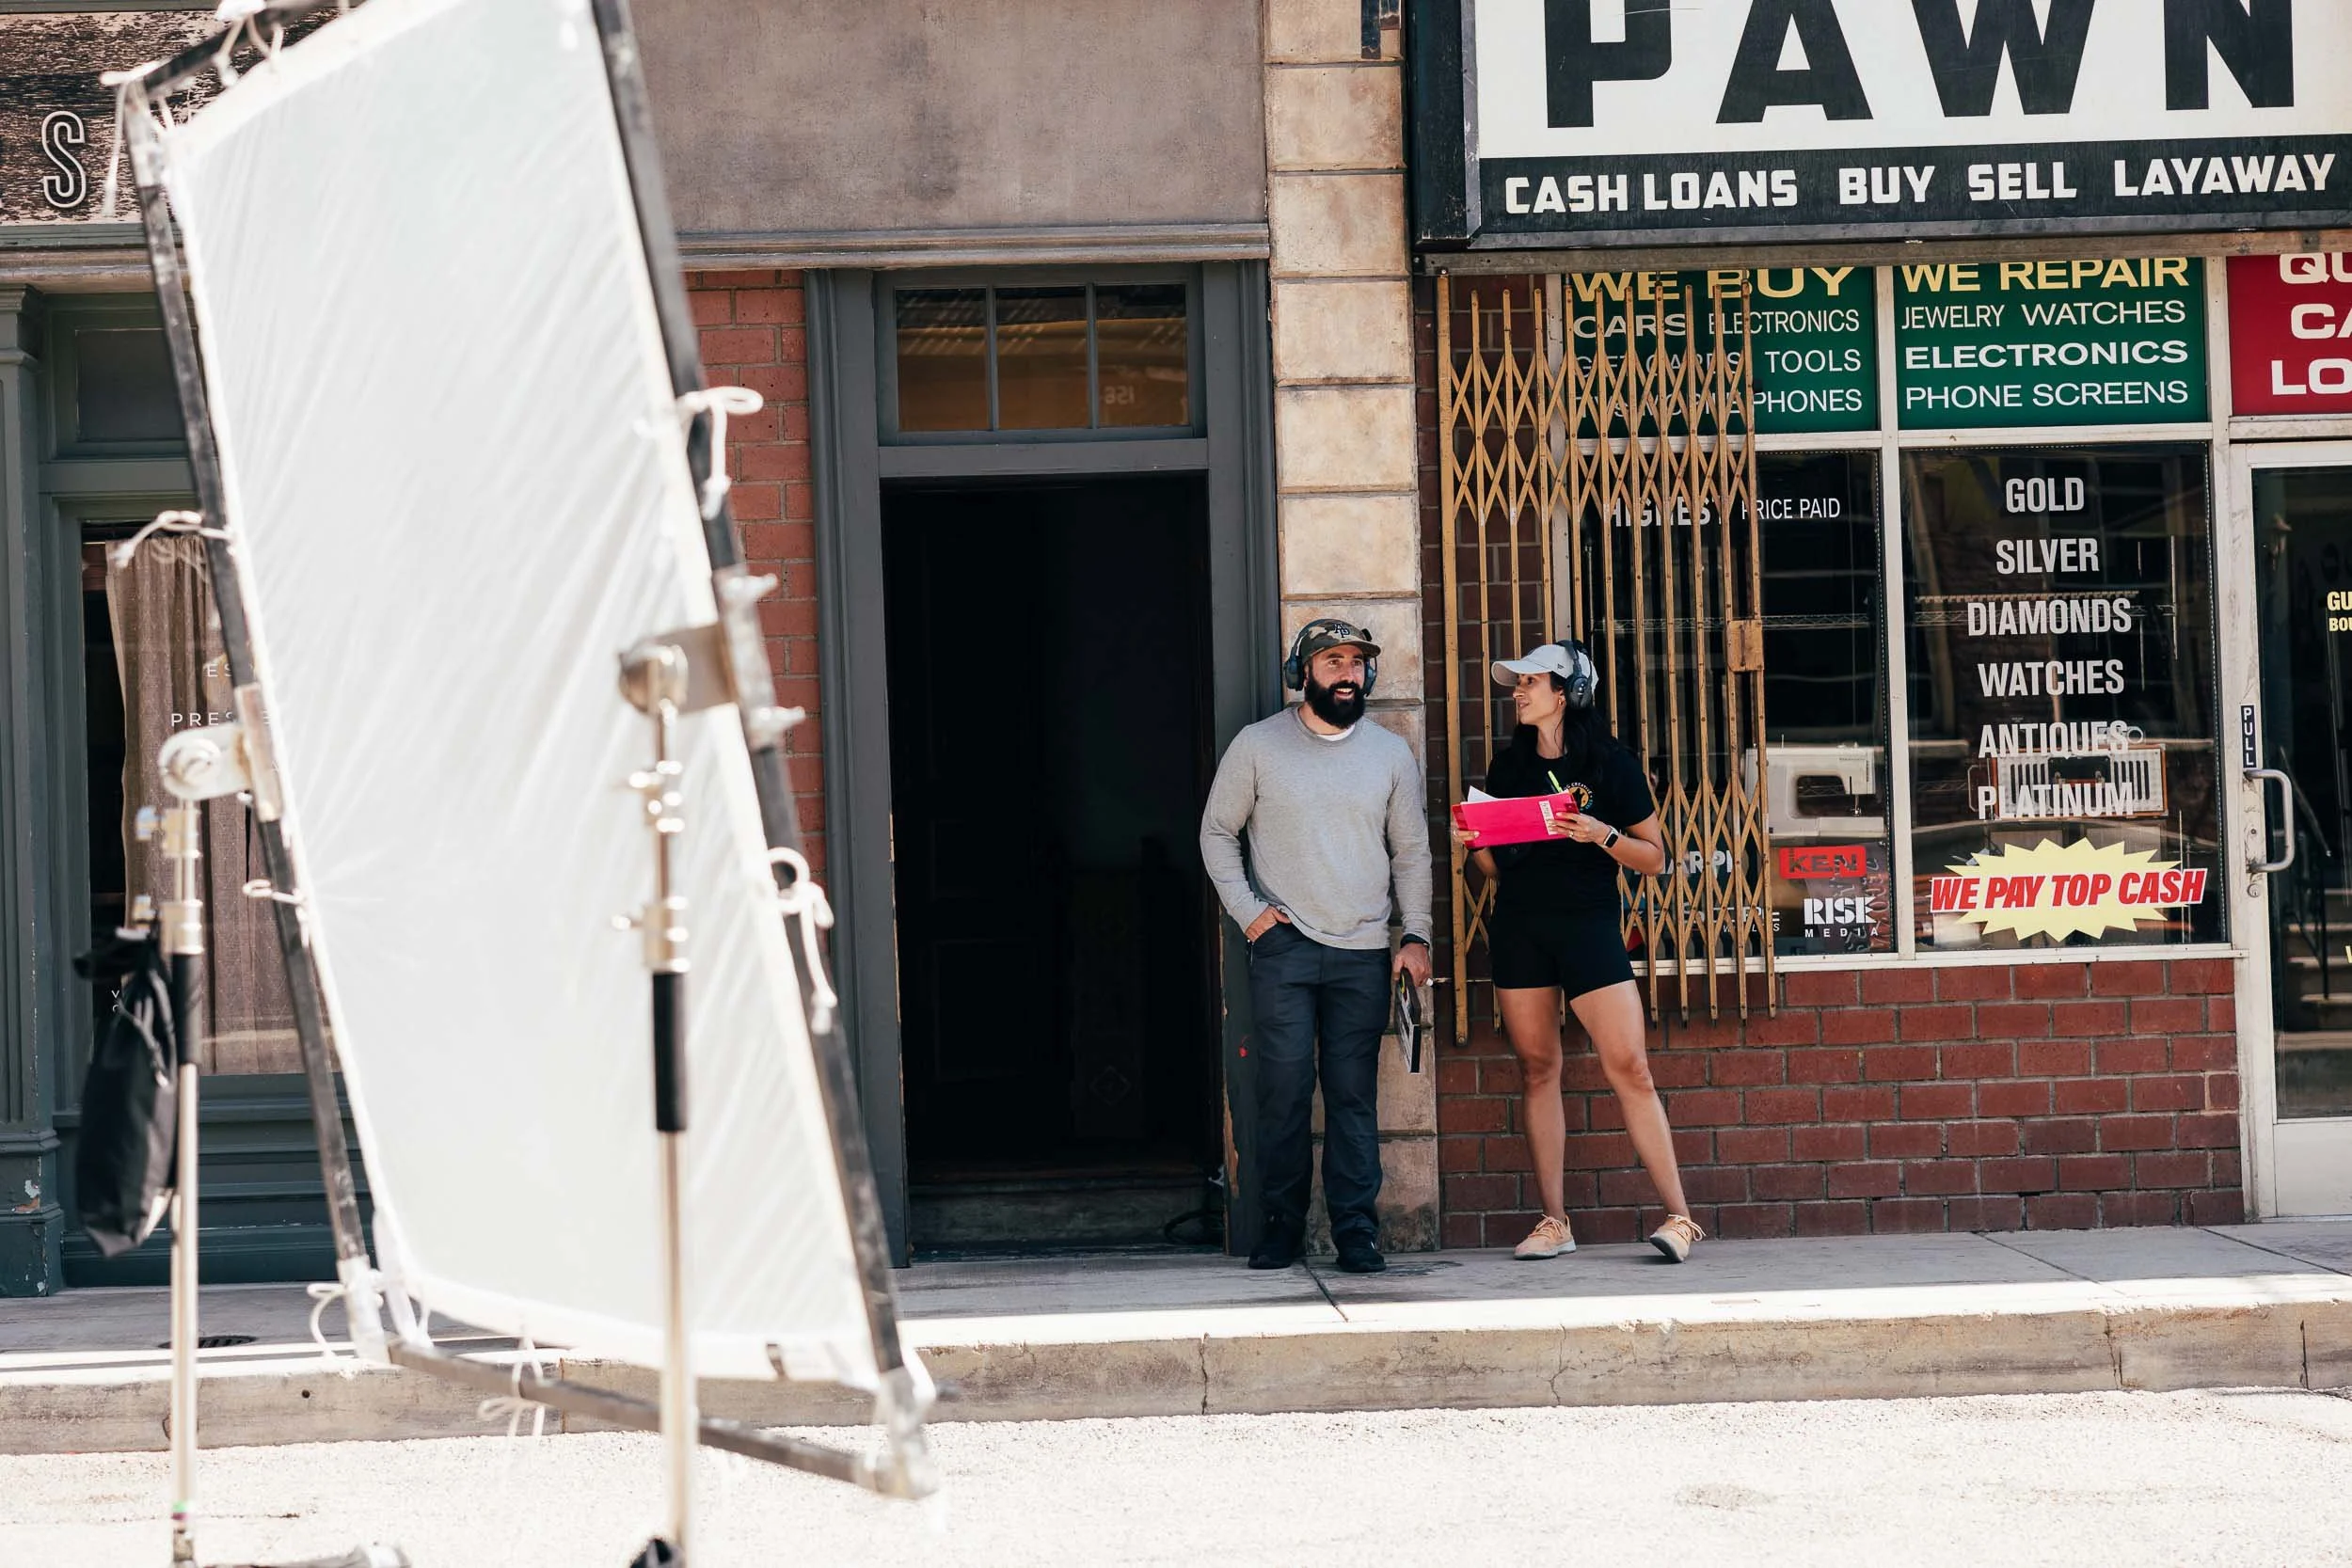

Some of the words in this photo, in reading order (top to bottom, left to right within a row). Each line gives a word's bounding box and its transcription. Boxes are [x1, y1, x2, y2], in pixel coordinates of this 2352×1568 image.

[1545, 0, 2295, 128] PAWN
[1504, 175, 1628, 214] CASH
[1644, 169, 1798, 211] LOANS
[1838, 166, 1934, 205] BUY
[1969, 160, 2077, 201] SELL
[2113, 153, 2337, 197] LAYAWAY
[1571, 270, 1680, 302] WE
[1707, 267, 1855, 299] BUY
[1901, 263, 1981, 293] WE
[1999, 257, 2189, 292] REPAIR
[1573, 313, 1688, 339] CARS
[1708, 309, 1860, 335] ELECTRONICS
[1901, 304, 2006, 330] JEWELRY
[2021, 299, 2186, 326] WATCHES
[1765, 349, 1862, 374] TOOLS
[1905, 340, 2188, 370] ELECTRONICS
[1752, 388, 1863, 414] PHONES
[1906, 384, 2023, 410] PHONE
[2032, 380, 2189, 406] SCREENS
[1799, 498, 1841, 519] PAID
[2005, 477, 2085, 513] GOLD
[1995, 538, 2100, 574] SILVER
[1967, 597, 2132, 637] DIAMONDS
[1978, 658, 2124, 697] WATCHES
[1978, 720, 2129, 760] ANTIQUES
[2243, 706, 2254, 766] PULL
[1978, 782, 2135, 820] PLATINUM
[1931, 878, 1979, 911] WE
[1984, 875, 2045, 910] PAY
[2051, 873, 2111, 907] TOP
[2118, 869, 2207, 905] CASH
[1804, 896, 1878, 926] RISK
[1804, 927, 1880, 939] MEDIA
